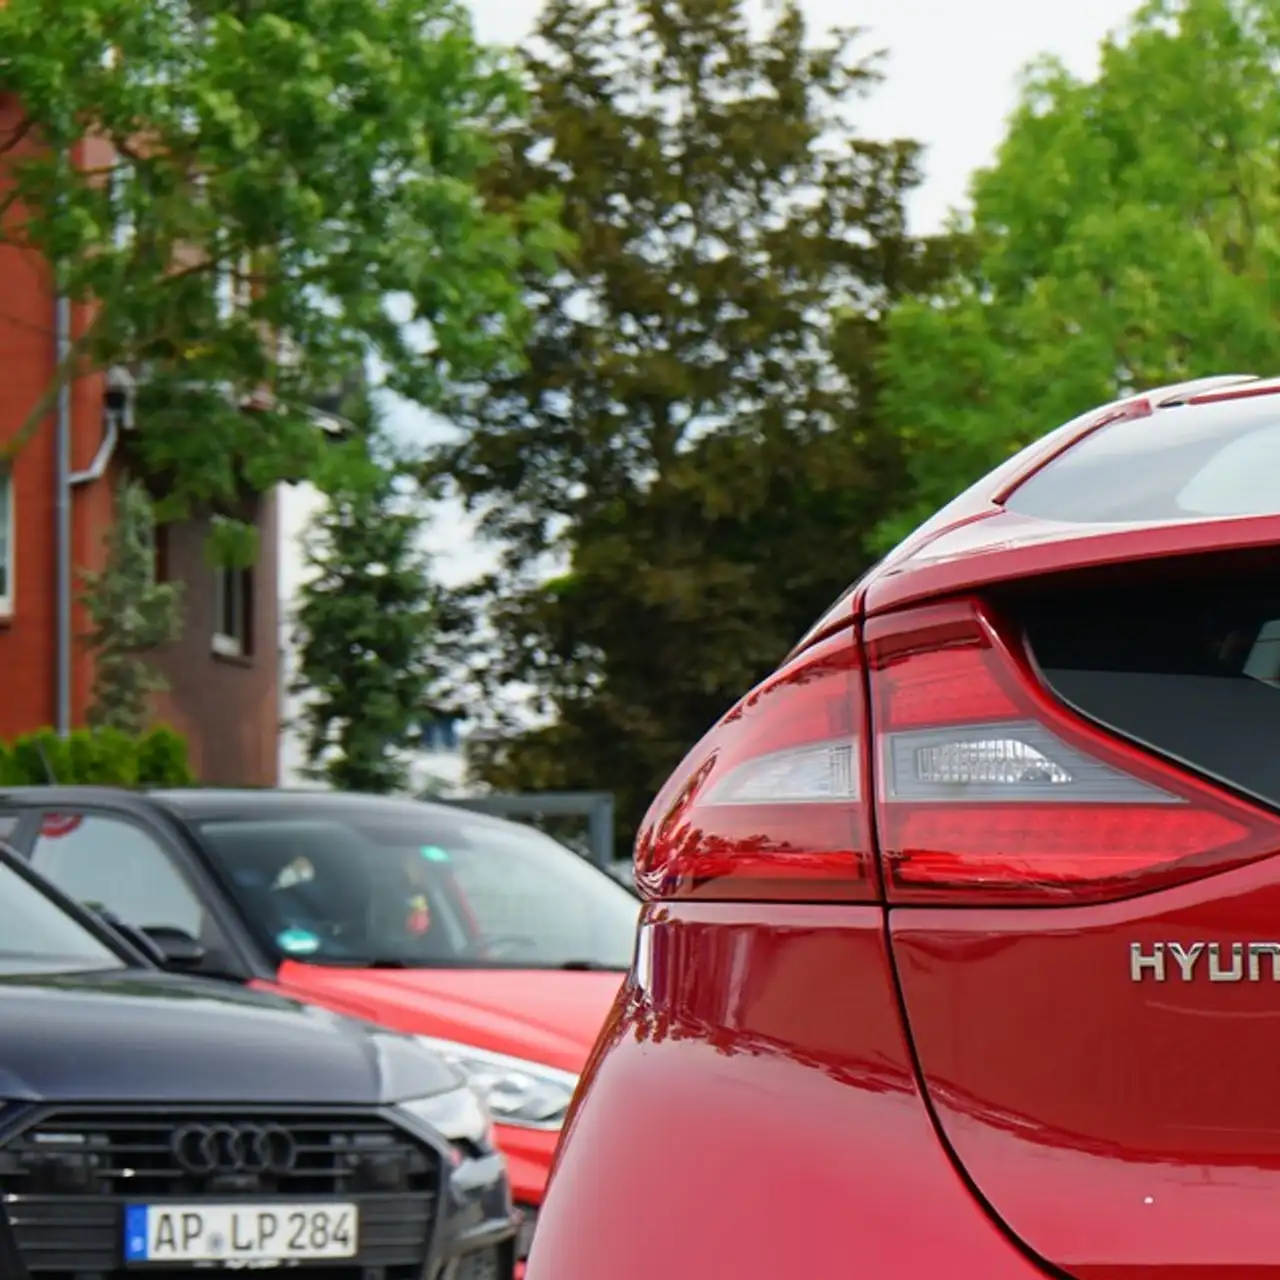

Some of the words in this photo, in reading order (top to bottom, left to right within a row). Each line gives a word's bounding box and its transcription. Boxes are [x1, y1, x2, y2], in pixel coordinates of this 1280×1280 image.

[154, 1212, 204, 1252] AP
[230, 1212, 279, 1252] LP
[287, 1211, 350, 1251] 284
